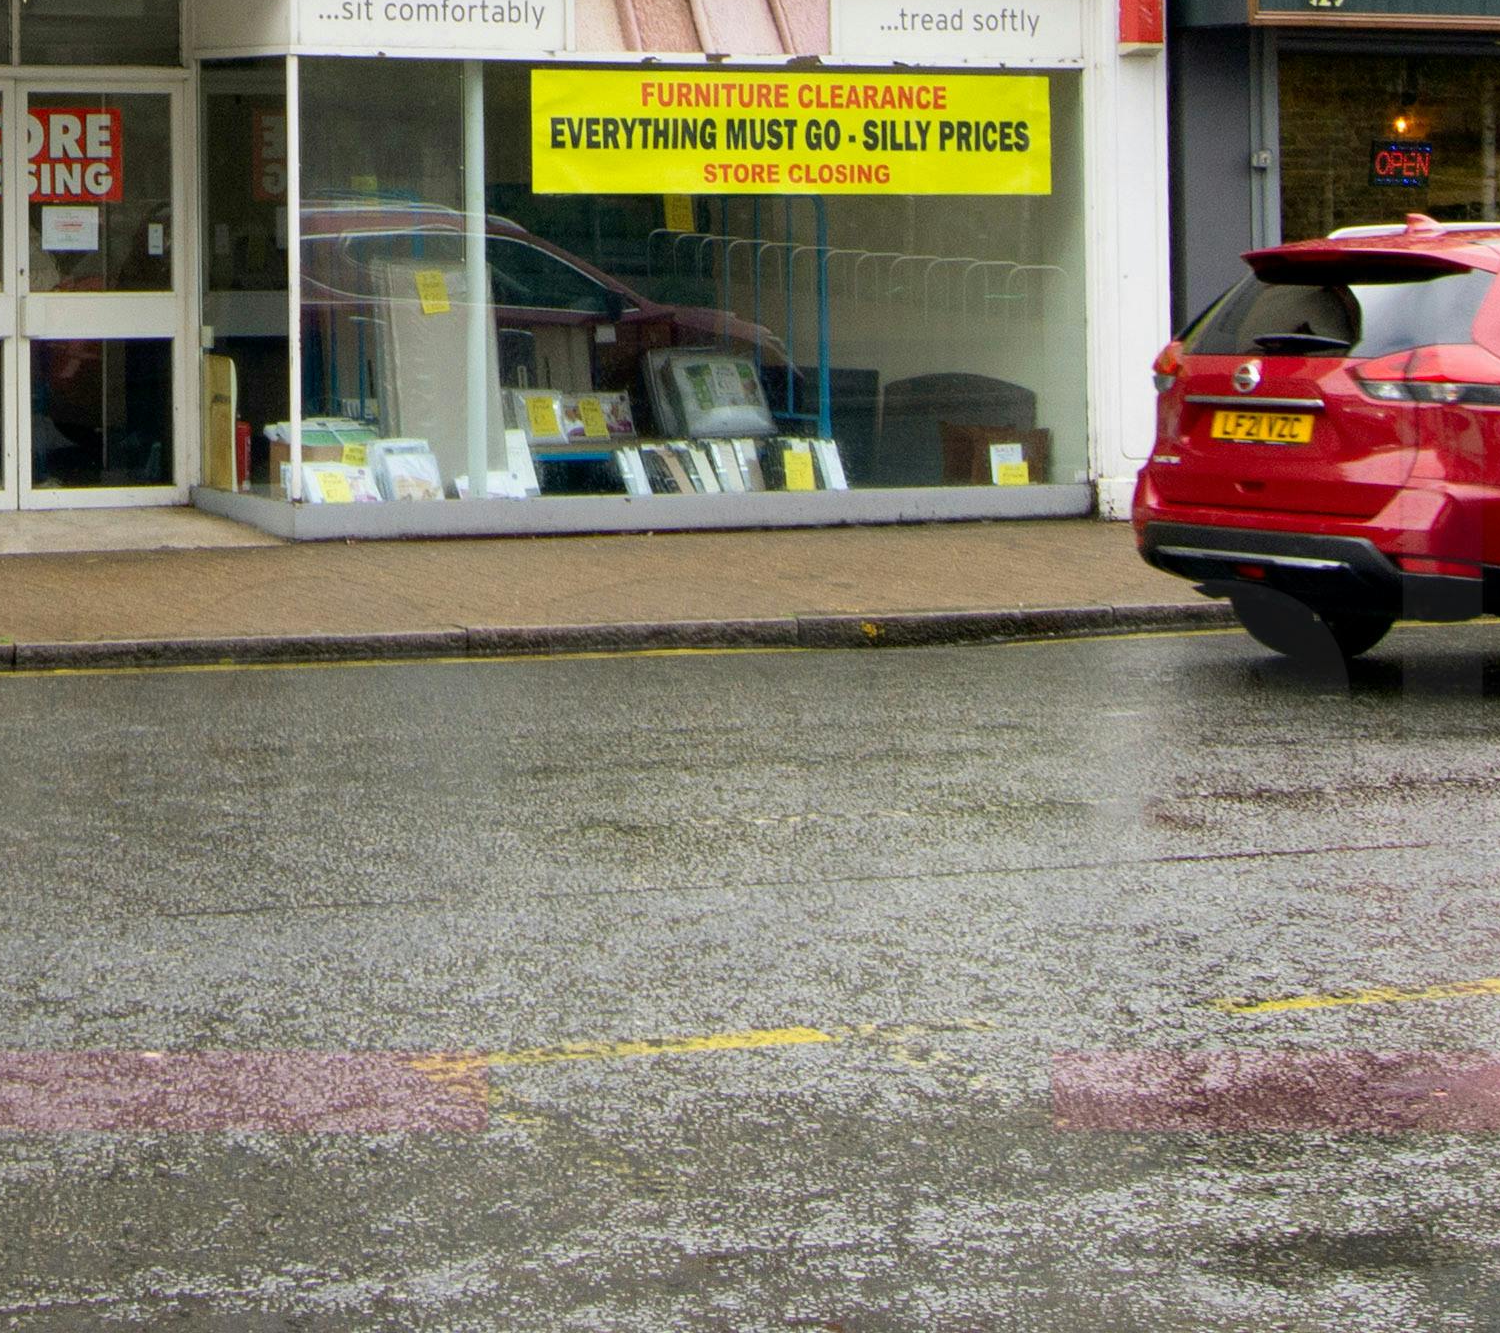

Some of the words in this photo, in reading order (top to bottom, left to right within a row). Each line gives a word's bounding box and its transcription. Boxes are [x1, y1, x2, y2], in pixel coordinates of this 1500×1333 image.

[972, 7, 1040, 39] softly
[641, 82, 789, 108] FURNITURE
[798, 84, 947, 110] CLEARANCE
[550, 117, 717, 151] EVERYTHING
[726, 119, 797, 152] MUST
[805, 120, 841, 152] GO
[862, 120, 933, 153] SILLY
[938, 121, 1030, 154] PRICES
[703, 164, 782, 185] STORE
[789, 164, 891, 185] CLOSING
[1375, 152, 1430, 177] OPEN
[1268, 415, 1302, 439] VZC
